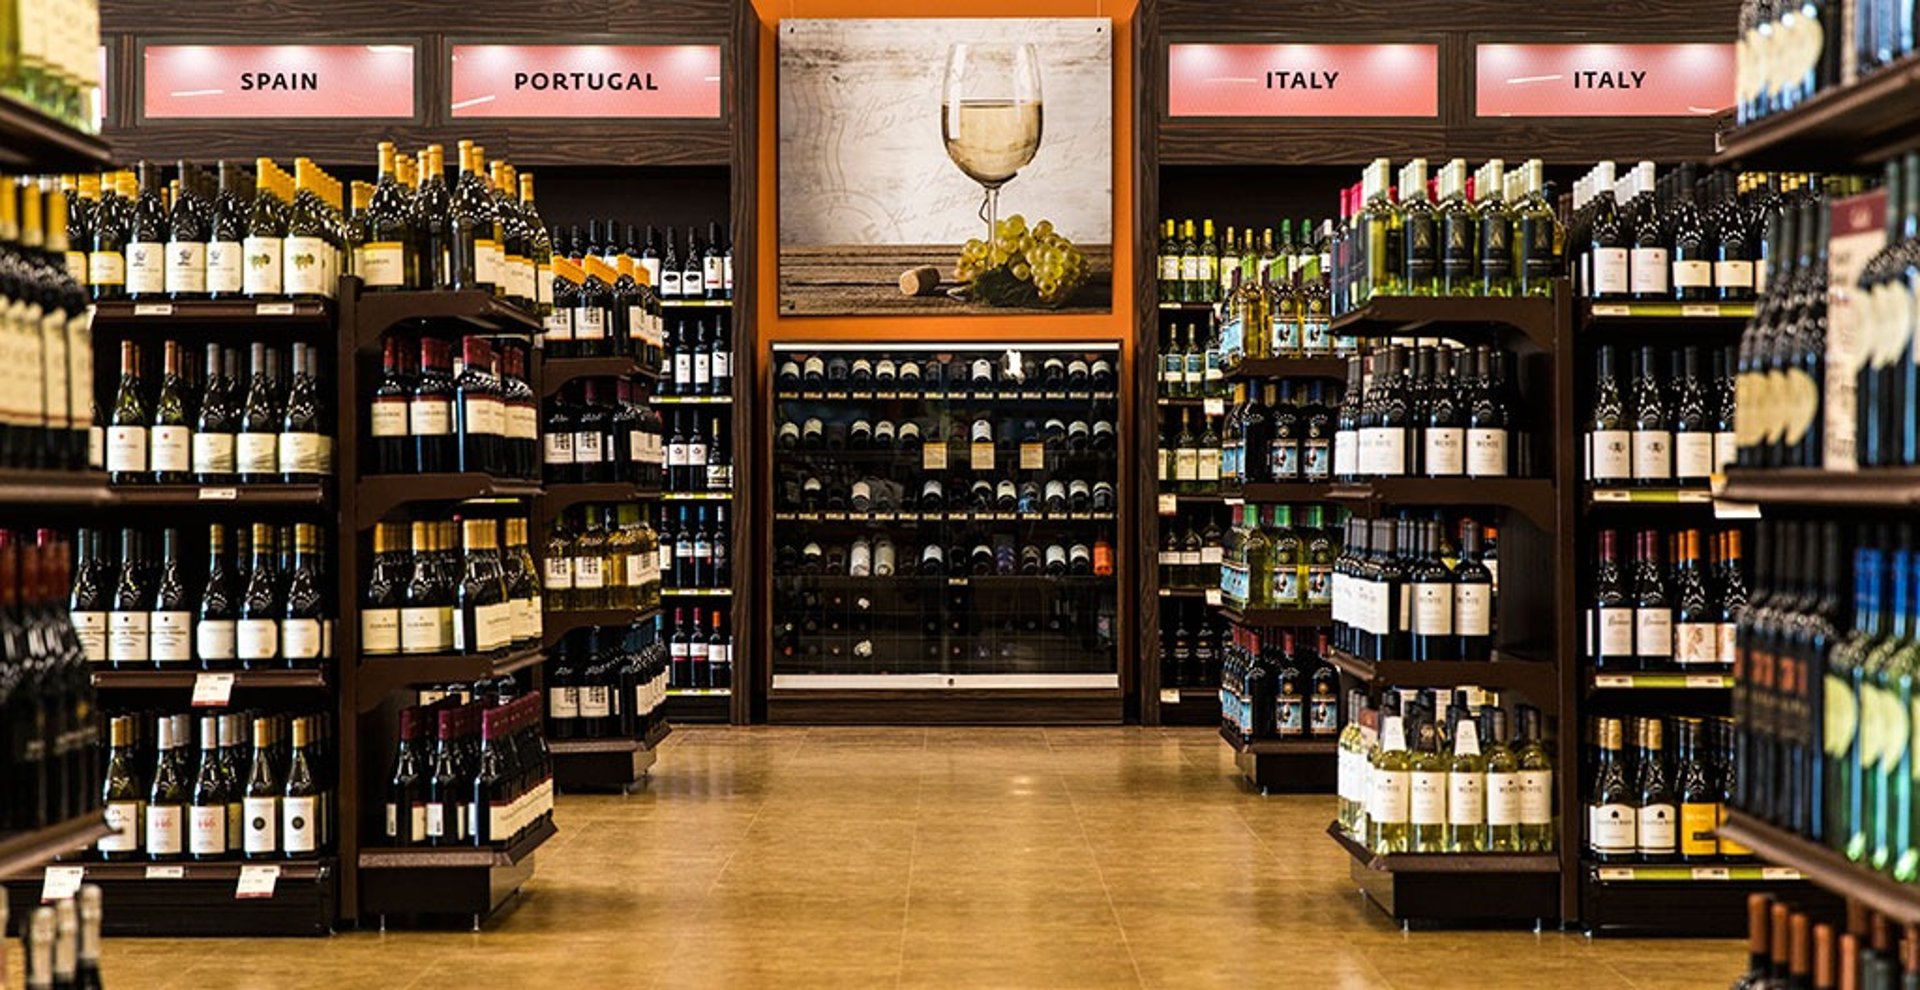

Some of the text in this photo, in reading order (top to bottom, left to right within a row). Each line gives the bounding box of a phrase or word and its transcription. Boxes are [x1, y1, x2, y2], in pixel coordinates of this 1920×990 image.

[241, 72, 318, 91] SPAIN
[514, 72, 659, 91] PORTUGAL
[1266, 71, 1339, 90] ITALY
[1574, 71, 1647, 90] ITALY
